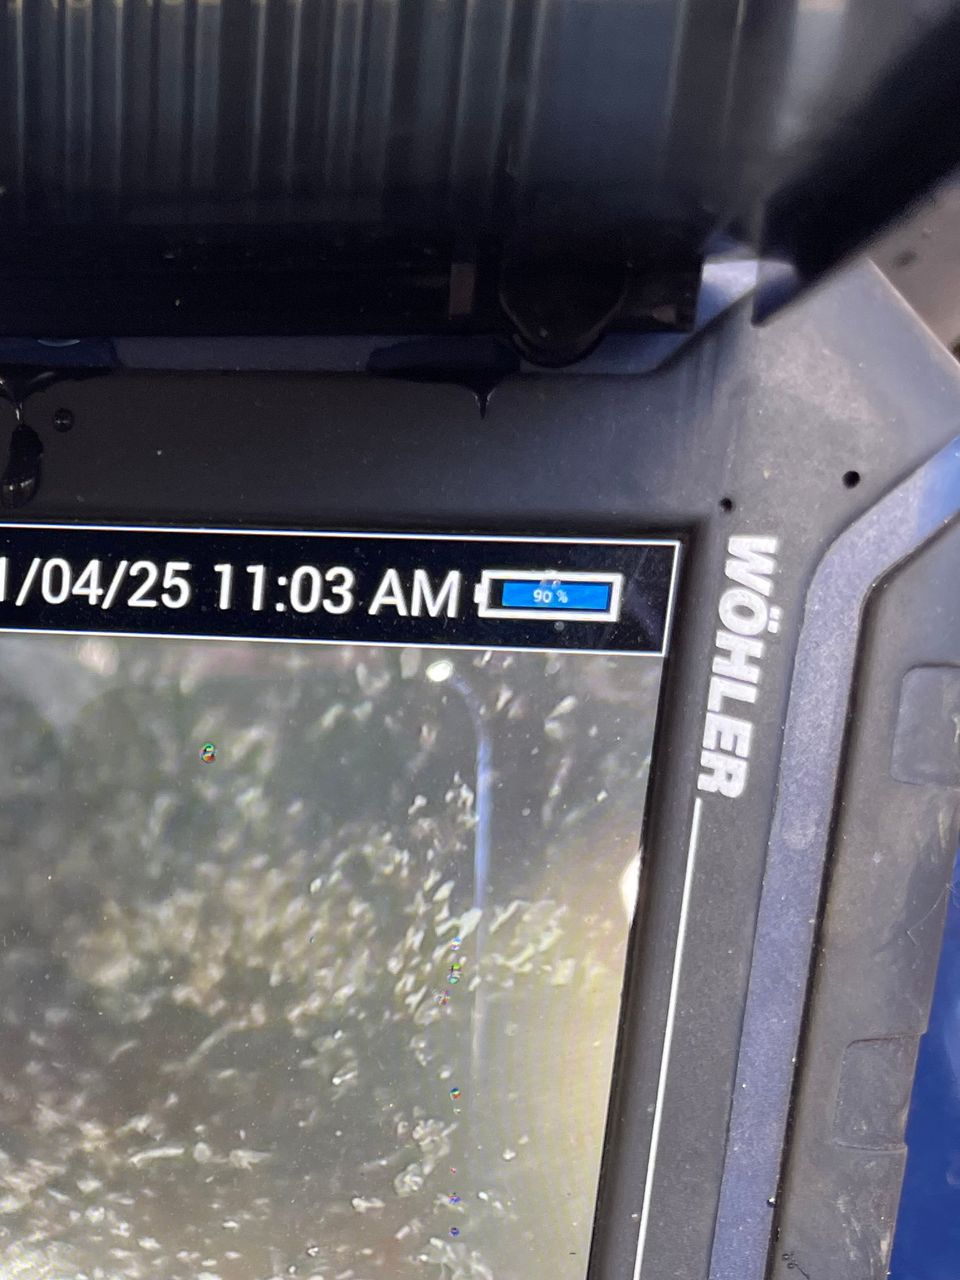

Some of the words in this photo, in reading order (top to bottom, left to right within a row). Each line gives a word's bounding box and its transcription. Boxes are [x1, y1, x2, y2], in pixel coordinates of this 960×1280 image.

[214, 563, 355, 615] 11:03
[368, 568, 461, 618] AM
[695, 535, 781, 799] WÖHLER
